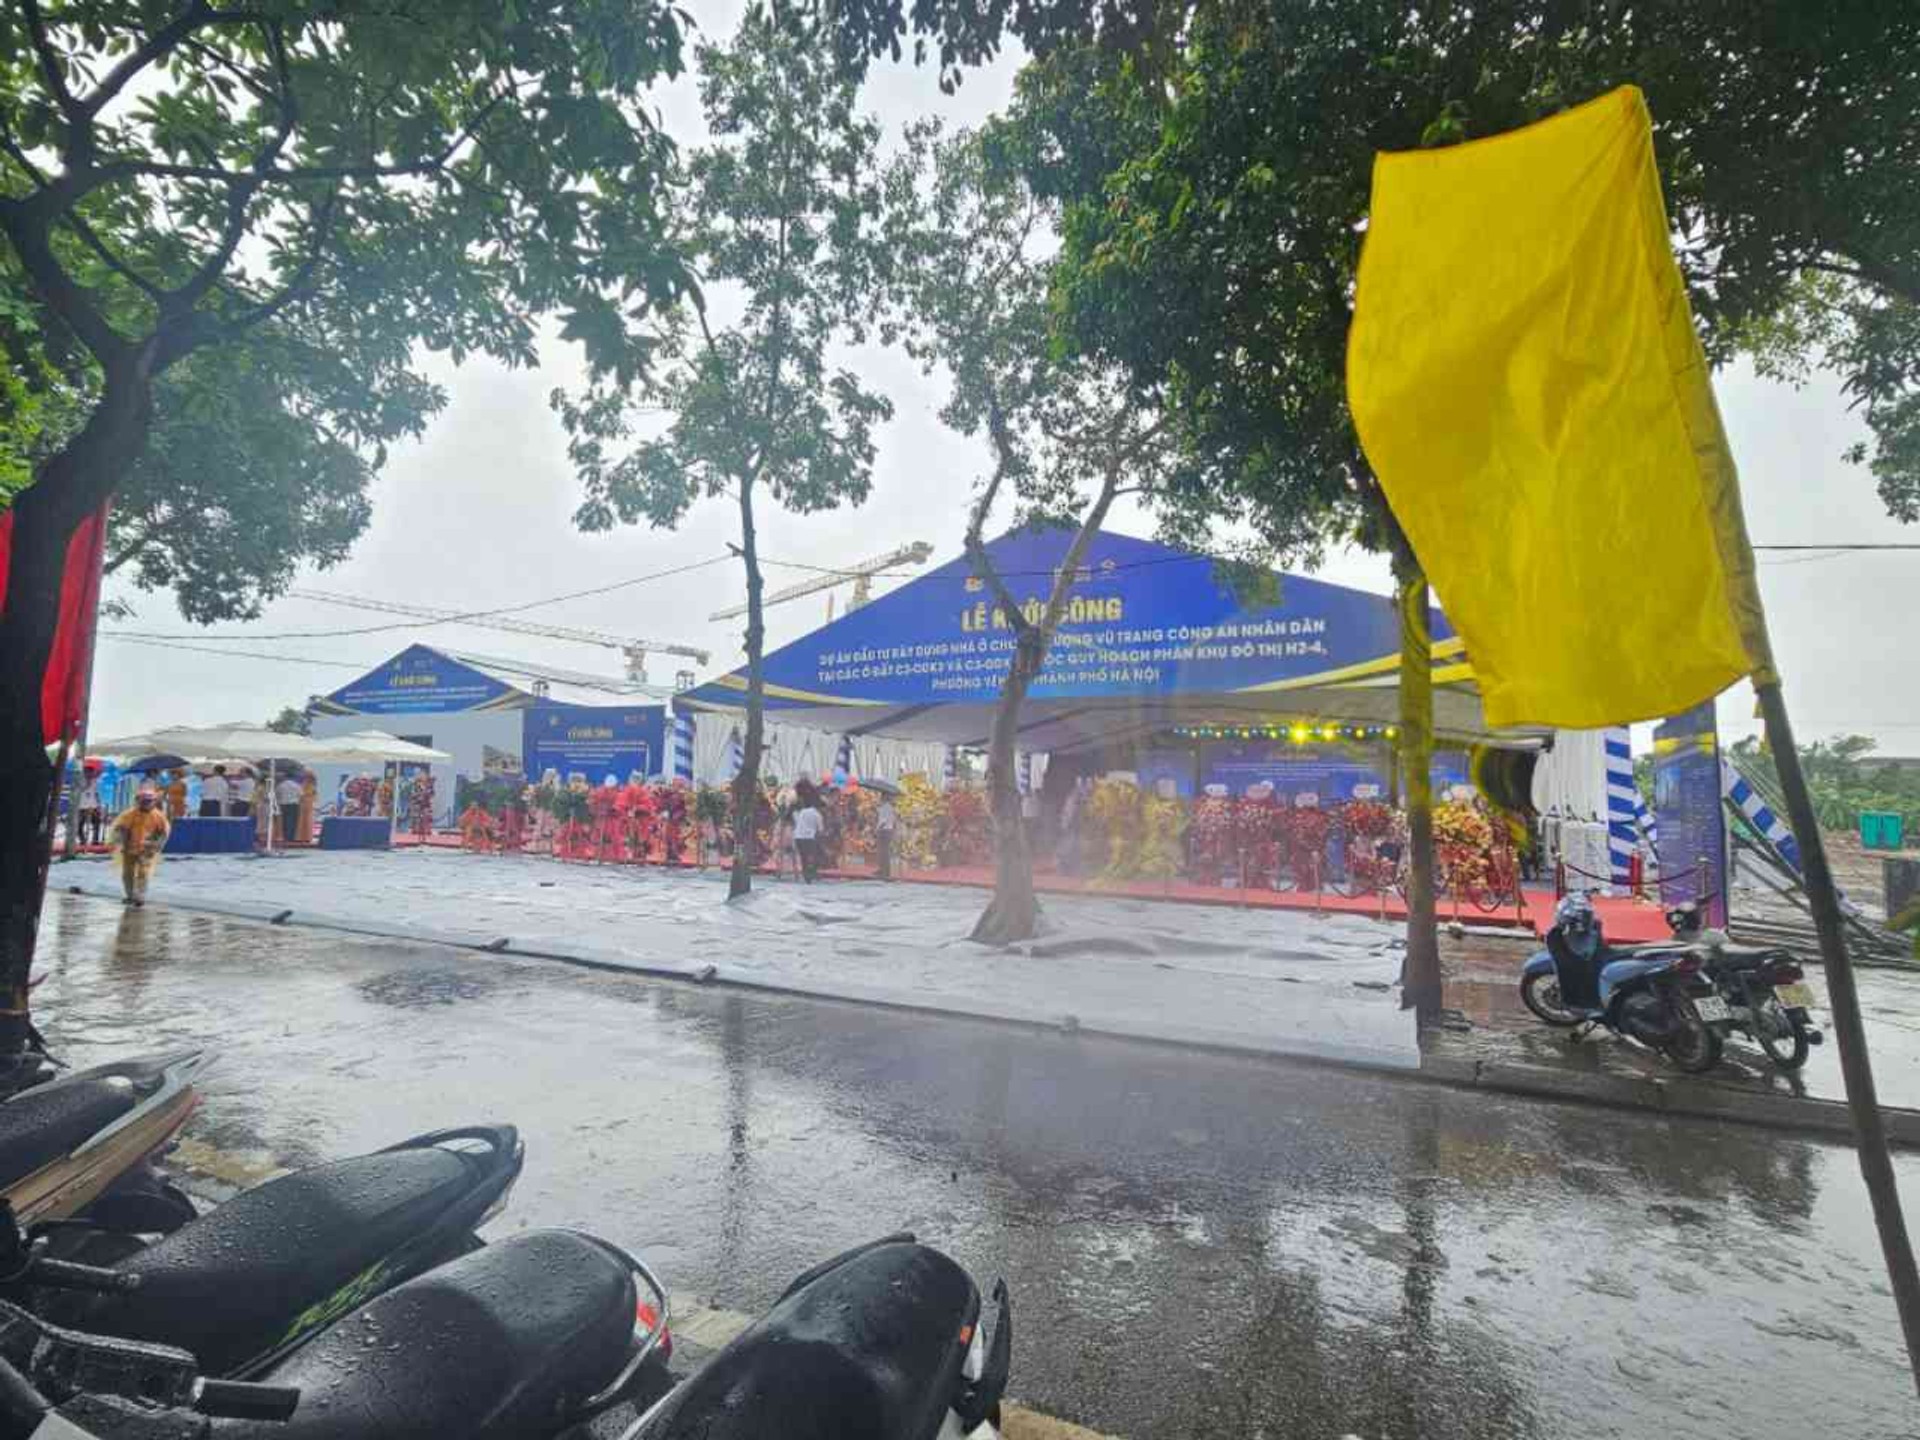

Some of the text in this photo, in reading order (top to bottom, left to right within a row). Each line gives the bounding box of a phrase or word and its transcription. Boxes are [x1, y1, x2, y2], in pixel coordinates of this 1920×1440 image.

[1116, 628, 1163, 644] TRANG
[1167, 624, 1212, 640] CÔNG
[1216, 623, 1237, 638] AN
[1241, 619, 1286, 638] NHÂN
[1289, 617, 1325, 635] DÂN
[1068, 650, 1096, 663] QUY
[1100, 647, 1149, 664] HOẠCH
[1153, 645, 1194, 661] PHÂN
[1231, 641, 1254, 657] ĐÔ
[1258, 642, 1282, 659] THỊ
[1079, 666, 1106, 683] PHỐ
[1110, 667, 1130, 682] HÀ
